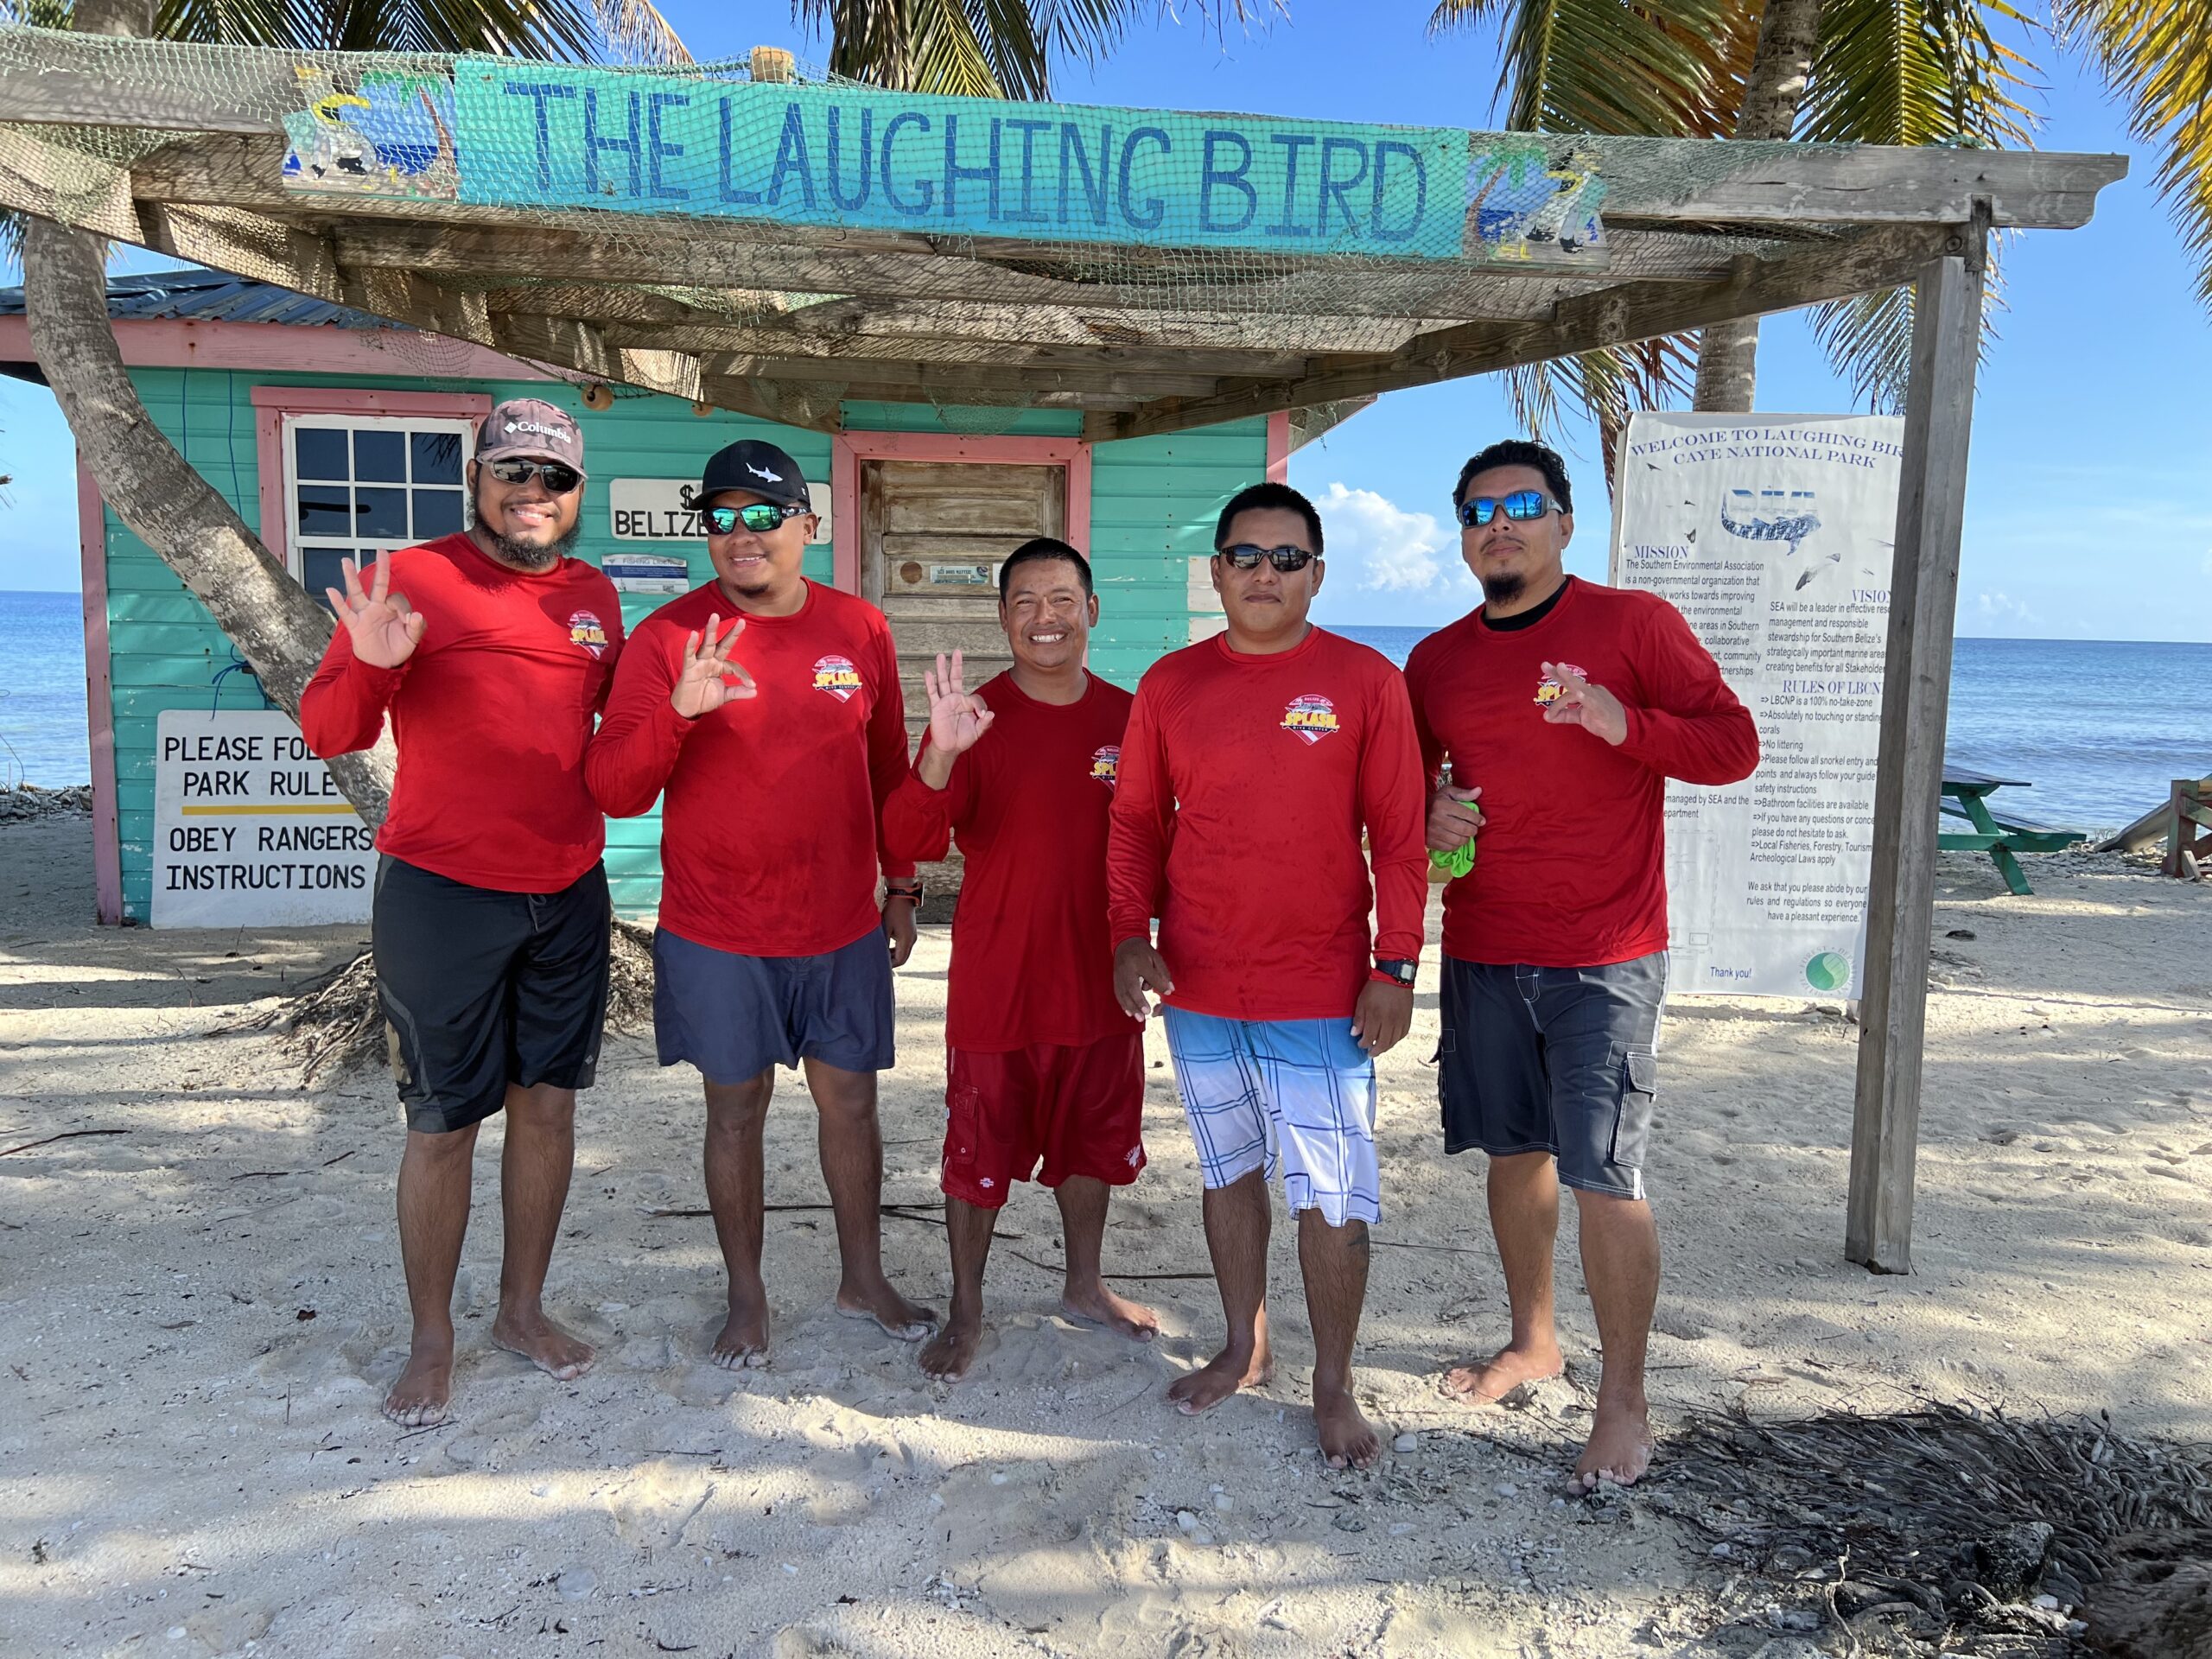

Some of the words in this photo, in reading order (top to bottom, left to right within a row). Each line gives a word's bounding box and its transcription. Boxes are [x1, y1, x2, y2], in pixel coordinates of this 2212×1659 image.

[504, 81, 690, 200] THE
[718, 96, 1171, 231] LAUGHING
[1200, 129, 1427, 245] BIRD
[518, 421, 571, 443] Columbia
[1631, 432, 1726, 456] WELCOME
[1732, 429, 1758, 442] TO
[1764, 429, 1866, 448] LAUGHING
[1872, 441, 1904, 457] BIR
[1674, 448, 1721, 465] CAYE
[1727, 446, 1821, 460] NATIONAL
[1827, 450, 1877, 468] PARK
[1634, 545, 1688, 559] MISSION
[1626, 559, 1639, 569] The
[1641, 559, 1672, 569] Southern
[1674, 560, 1722, 570] Environmental
[1724, 561, 1764, 570] Association
[1625, 575, 1630, 584] is
[1638, 575, 1700, 587] non-governmental
[1701, 575, 1744, 588] organization
[1745, 575, 1760, 586] that
[1669, 590, 1689, 600] works
[1691, 590, 1719, 601] towards
[1720, 590, 1755, 603] improving
[1681, 605, 1692, 614] the
[1694, 606, 1742, 615] environmental
[1770, 601, 1784, 612] SEA
[1786, 601, 1797, 612] will
[1799, 601, 1808, 613] be
[1809, 604, 1814, 613] a
[1815, 602, 1837, 613] leader
[1839, 603, 1844, 613] in
[1846, 603, 1875, 613] effective
[1699, 621, 1718, 630] areas
[1720, 621, 1726, 630] in
[1728, 620, 1759, 631] Southern
[1769, 618, 1813, 629] management
[1815, 618, 1827, 627] and
[1829, 619, 1868, 630] responsible
[1705, 635, 1749, 645] collaborative
[1768, 632, 1809, 645] stewardship
[1811, 632, 1821, 642] for
[1822, 632, 1853, 643] Southern
[1855, 633, 1881, 644] Belize's
[1724, 652, 1761, 664] community
[1766, 646, 1808, 659] strategically
[1810, 647, 1843, 660] important
[1845, 649, 1867, 658] marine
[1719, 665, 1754, 677] tnerships
[1765, 662, 1794, 674] creating
[1796, 662, 1822, 672] benefits
[1824, 663, 1834, 672] for
[815, 671, 860, 687] SPLASH
[1538, 684, 1567, 702] SPL
[1783, 680, 1825, 694] RULES
[1827, 681, 1845, 695] OF
[1848, 682, 1882, 696] LBCN
[1770, 695, 1795, 705] LBCNP
[1796, 696, 1802, 705] is
[1810, 696, 1827, 706] 100%
[1829, 696, 1872, 708] no-take-zone
[1285, 712, 1337, 728] SPLASH
[1815, 711, 1844, 724] touching
[1846, 714, 1853, 722] or
[1758, 724, 1780, 734] corals
[164, 736, 264, 761] PLEASE
[1777, 741, 1803, 752] littering
[1789, 754, 1808, 765] follow
[1810, 755, 1819, 765] all
[1820, 755, 1845, 766] snorkel
[1847, 757, 1864, 768] entry
[1094, 761, 1116, 776] SPL
[1756, 769, 1777, 779] points
[1780, 769, 1792, 779] and
[1794, 770, 1817, 781] always
[1819, 770, 1838, 780] follow
[1840, 772, 1855, 782] your
[183, 771, 250, 797] PARK
[270, 771, 339, 796] RULE
[1755, 783, 1776, 795] safety
[1777, 784, 1817, 794] instructions
[1698, 795, 1707, 806] by
[1708, 794, 1722, 804] SEA
[1724, 795, 1737, 804] and
[1738, 795, 1749, 805] the
[1796, 798, 1824, 809] facilities
[1826, 801, 1838, 810] are
[1839, 799, 1869, 810] available
[1767, 815, 1779, 824] you
[1781, 813, 1797, 823] have
[1799, 816, 1811, 825] any
[1812, 814, 1844, 826] questions
[1846, 817, 1853, 825] or
[1854, 817, 1874, 825] conce
[169, 827, 237, 852] OBEY
[258, 825, 373, 851] RANGERS
[1751, 827, 1774, 838] please
[1776, 827, 1784, 837] do
[1786, 829, 1797, 837] not
[1798, 829, 1825, 838] hesitate
[1827, 830, 1833, 838] to
[1834, 830, 1848, 838] ask.
[1779, 840, 1811, 851] Fisheries,
[1814, 841, 1843, 853] Forestry,
[1751, 852, 1797, 865] Archeological
[1798, 854, 1815, 863] Laws
[1817, 855, 1835, 866] apply
[166, 864, 365, 890] INSTRUCTIONS
[1748, 881, 1758, 891] We
[1760, 882, 1772, 891] ask
[1774, 881, 1787, 892] that
[1789, 884, 1800, 893] you
[1802, 882, 1824, 893] please
[1825, 883, 1844, 893] abide
[1846, 884, 1853, 895] by
[1855, 885, 1868, 893] our
[1746, 896, 1764, 906] rules
[1767, 897, 1780, 906] and
[1783, 897, 1821, 908] regulations
[1835, 899, 1867, 910] everyone
[1767, 911, 1784, 920] have
[1790, 911, 1820, 922] pleasant
[1821, 912, 1859, 924] experience.
[1710, 966, 1733, 978] Thank
[1735, 968, 1751, 980] you!
